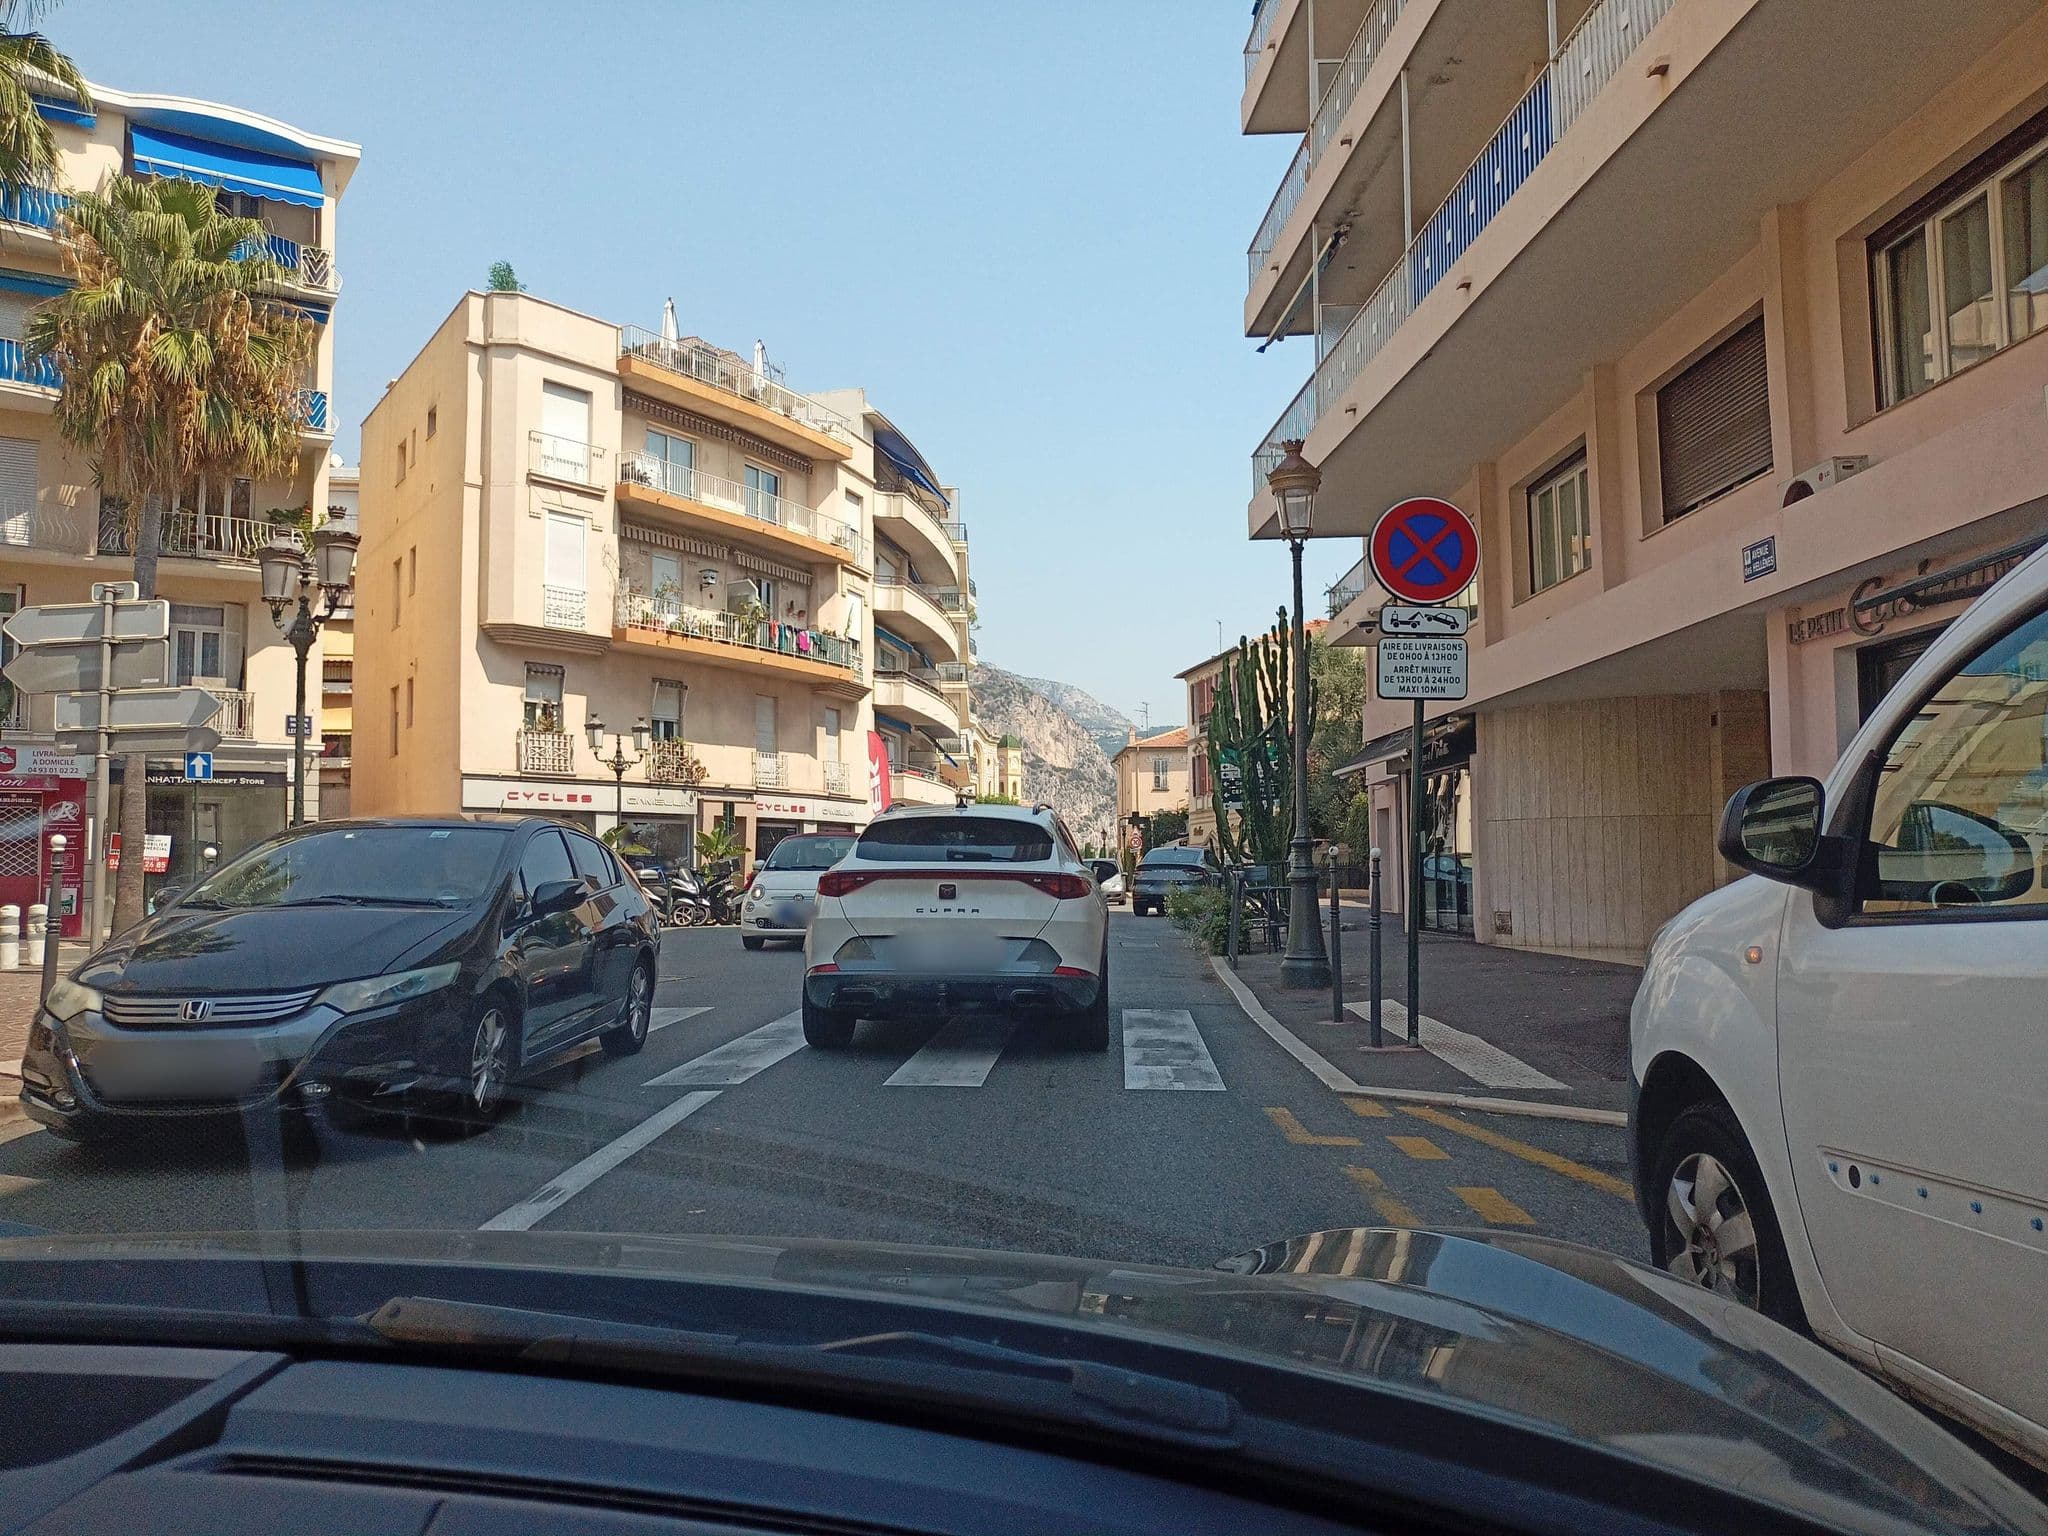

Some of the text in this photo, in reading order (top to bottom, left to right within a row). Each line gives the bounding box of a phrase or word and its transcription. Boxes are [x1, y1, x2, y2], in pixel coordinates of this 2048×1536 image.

[1382, 642, 1463, 651] AIRE DE LIVRAISONS
[1387, 652, 1397, 660] DE
[1424, 651, 1430, 661] À
[1431, 653, 1458, 661] 13H00
[1393, 664, 1452, 674] ARRÊT MINUTE
[1384, 674, 1461, 684] DE 13H00 À 24H00
[507, 791, 593, 803] CYCLES
[756, 803, 806, 813] CYCLES
